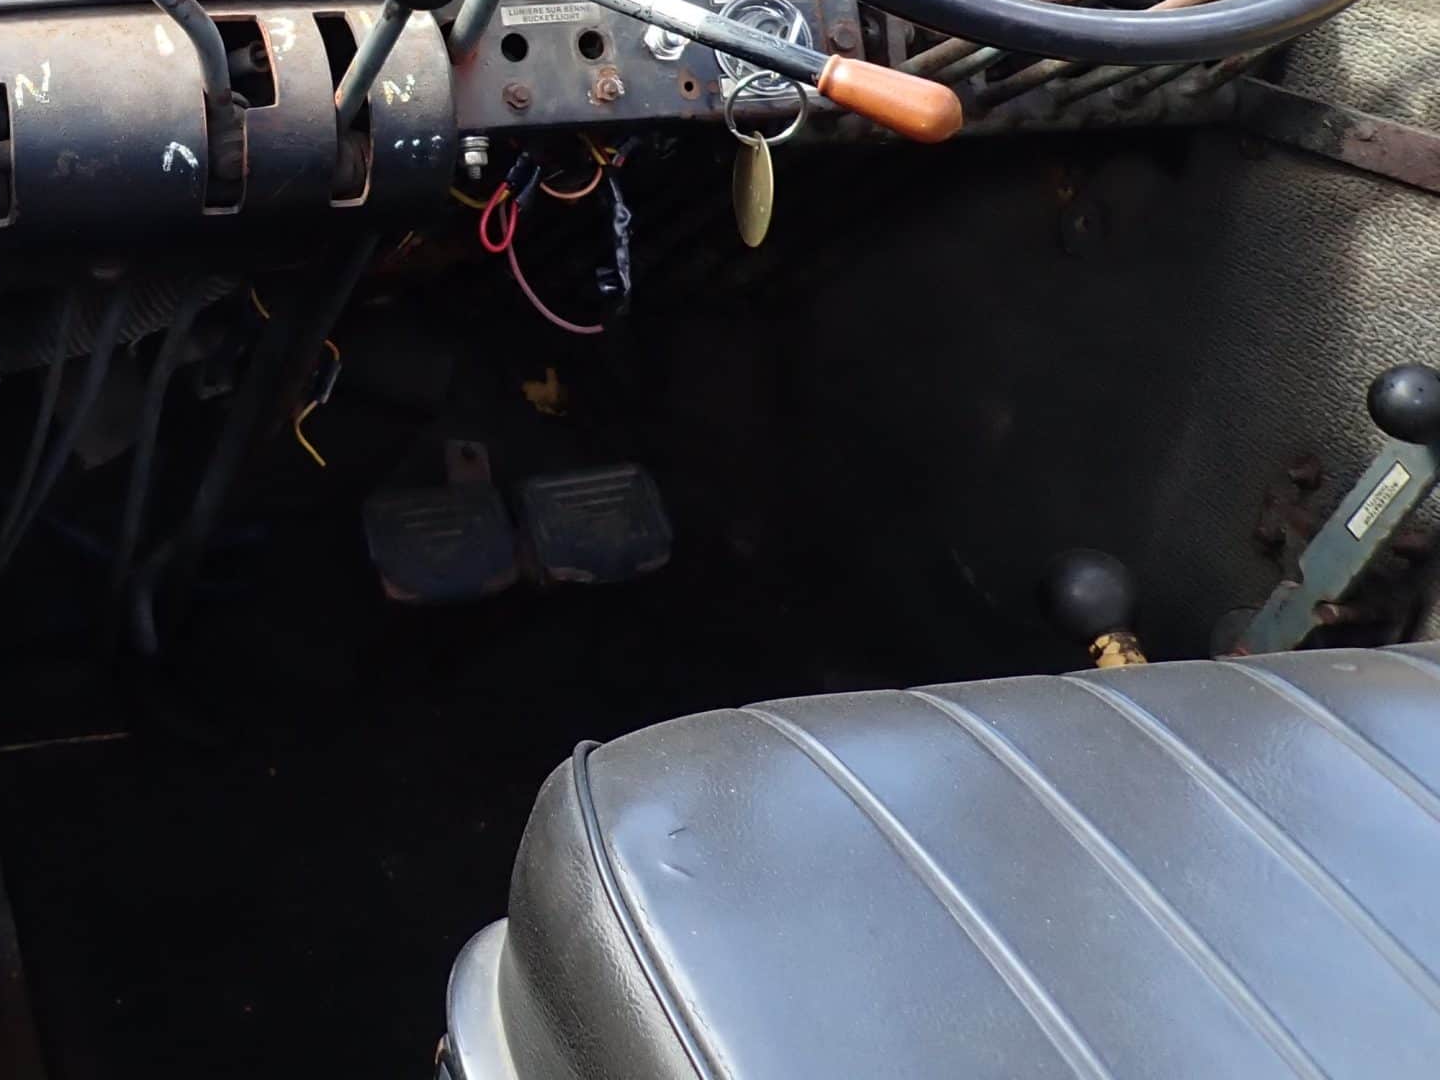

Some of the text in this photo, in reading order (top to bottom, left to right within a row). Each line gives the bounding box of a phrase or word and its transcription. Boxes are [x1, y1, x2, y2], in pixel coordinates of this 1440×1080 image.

[509, 8, 543, 17] LUMIERE
[544, 6, 562, 15] SUR
[14, 61, 50, 108] N
[382, 73, 416, 105] N
